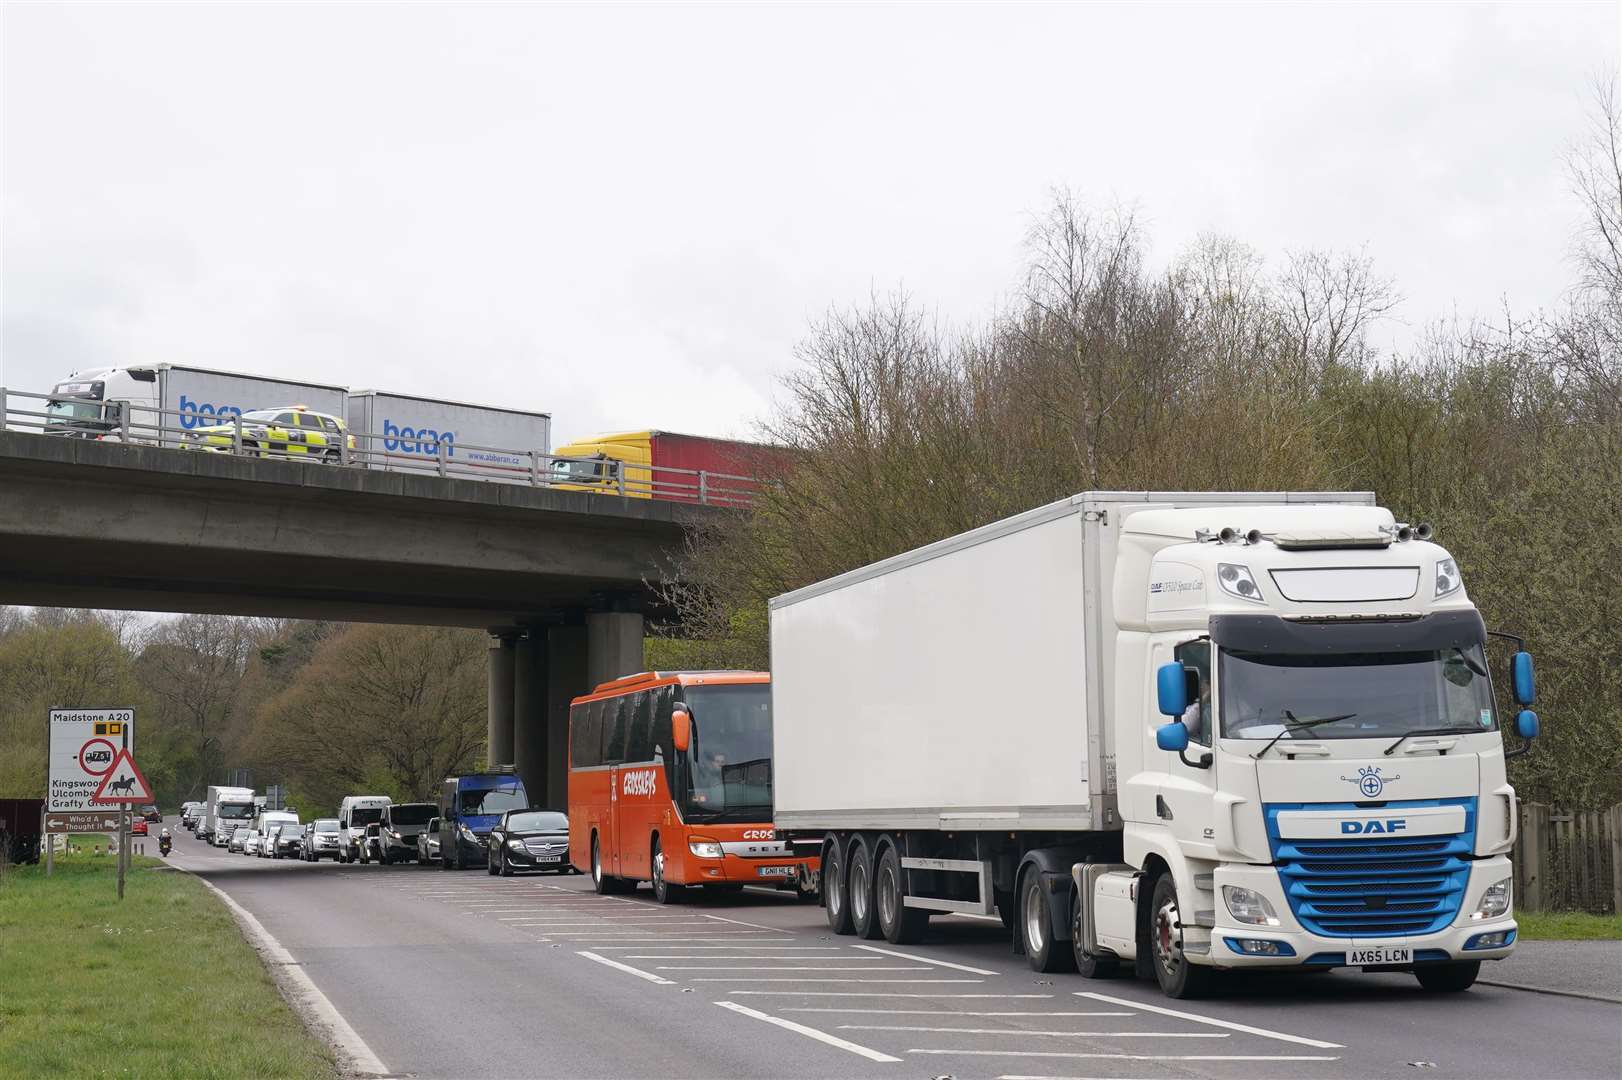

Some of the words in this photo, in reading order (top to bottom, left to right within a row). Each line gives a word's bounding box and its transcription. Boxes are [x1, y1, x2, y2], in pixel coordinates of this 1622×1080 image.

[383, 419, 454, 456] beran
[53, 713, 104, 722] Maidstone
[108, 713, 130, 721] A20
[1358, 765, 1381, 775] DAF
[52, 790, 94, 798] Ulcombe
[52, 800, 83, 809] Grafty
[65, 823, 94, 831] Thought
[1341, 820, 1406, 834] DAF
[1351, 951, 1382, 963] AX65
[1385, 949, 1409, 962] LCN
